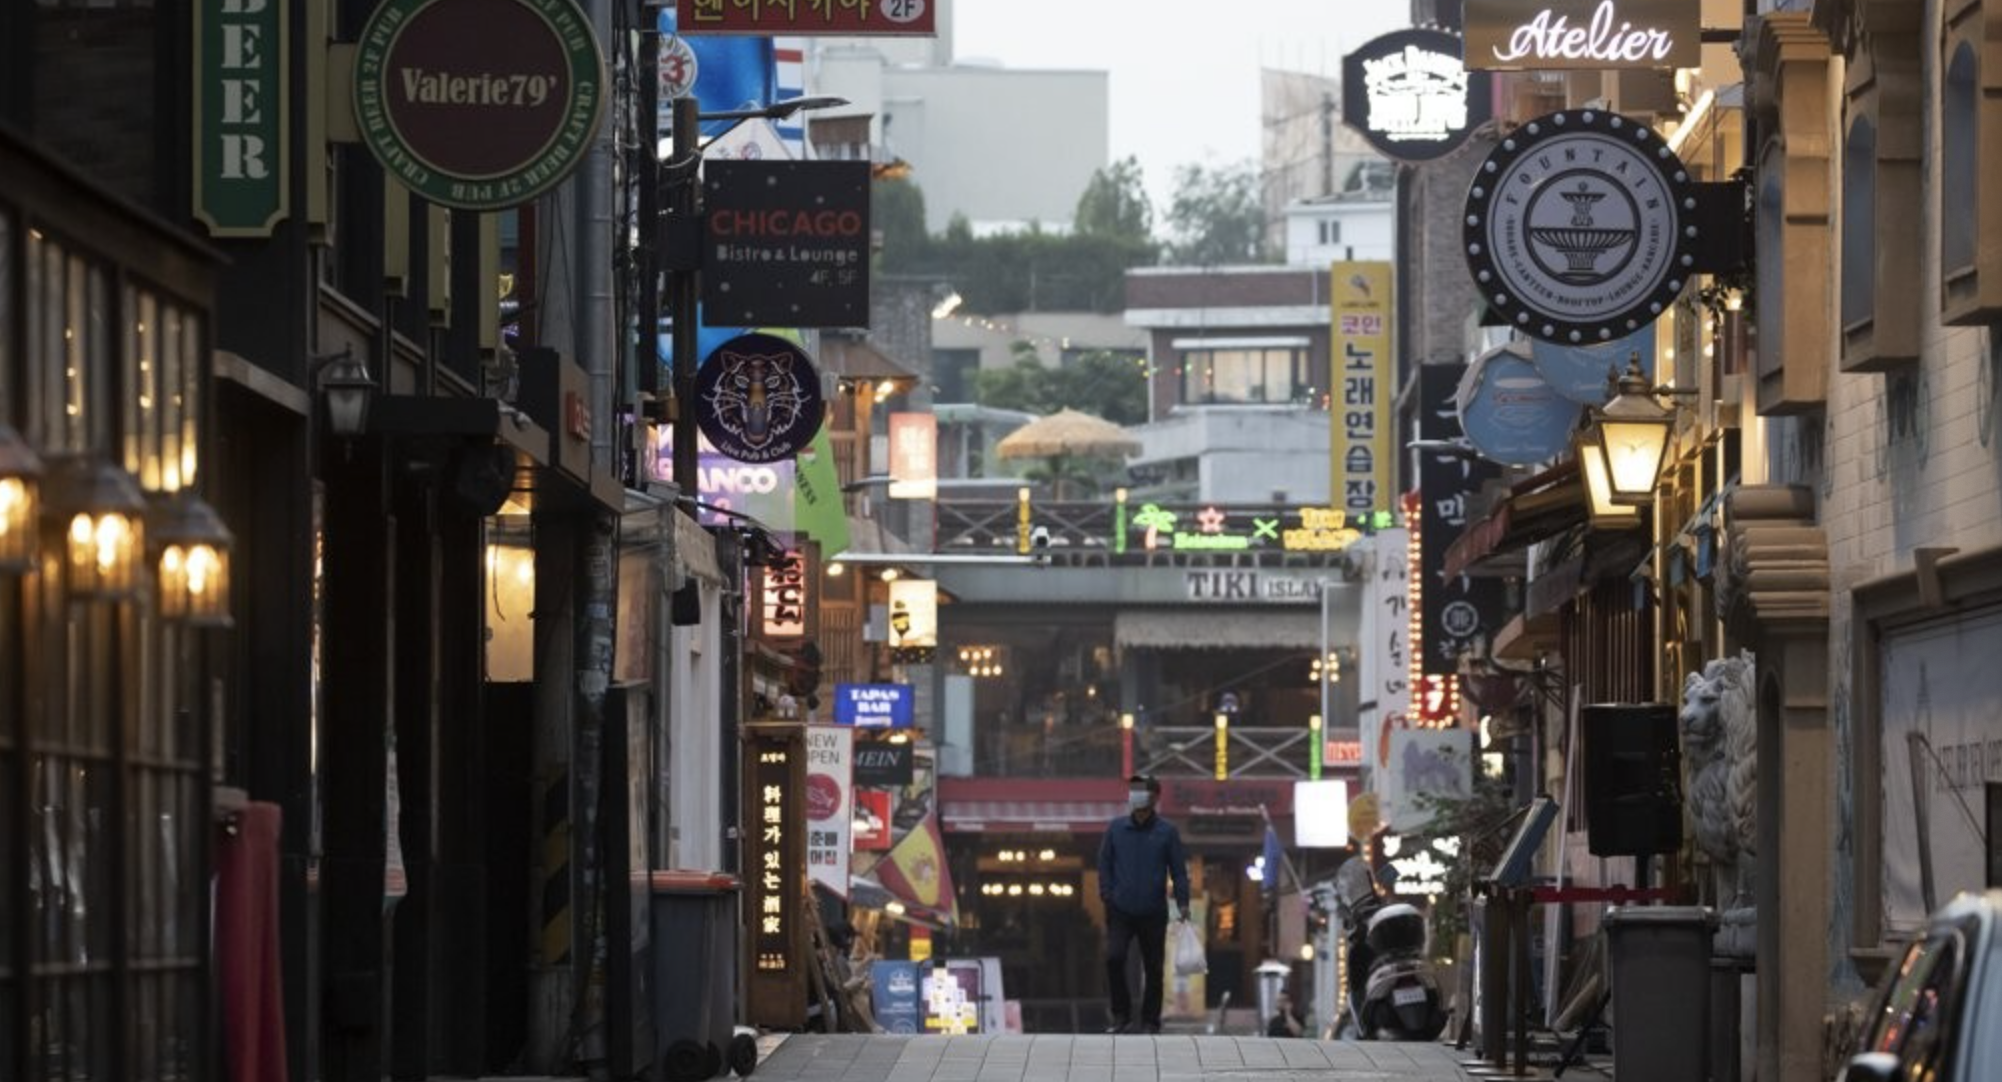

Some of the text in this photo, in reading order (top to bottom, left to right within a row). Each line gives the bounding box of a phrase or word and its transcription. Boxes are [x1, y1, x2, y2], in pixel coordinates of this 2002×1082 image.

[1492, 0, 1674, 61] Atelier
[1507, 149, 1660, 209] FOUNTAIN
[711, 210, 862, 236] CHICAGO
[1341, 315, 1382, 336] 코인
[1345, 343, 1376, 508] 노래연습장
[1187, 572, 1323, 598] TIKI ISLAN
[807, 751, 840, 764] PEN
